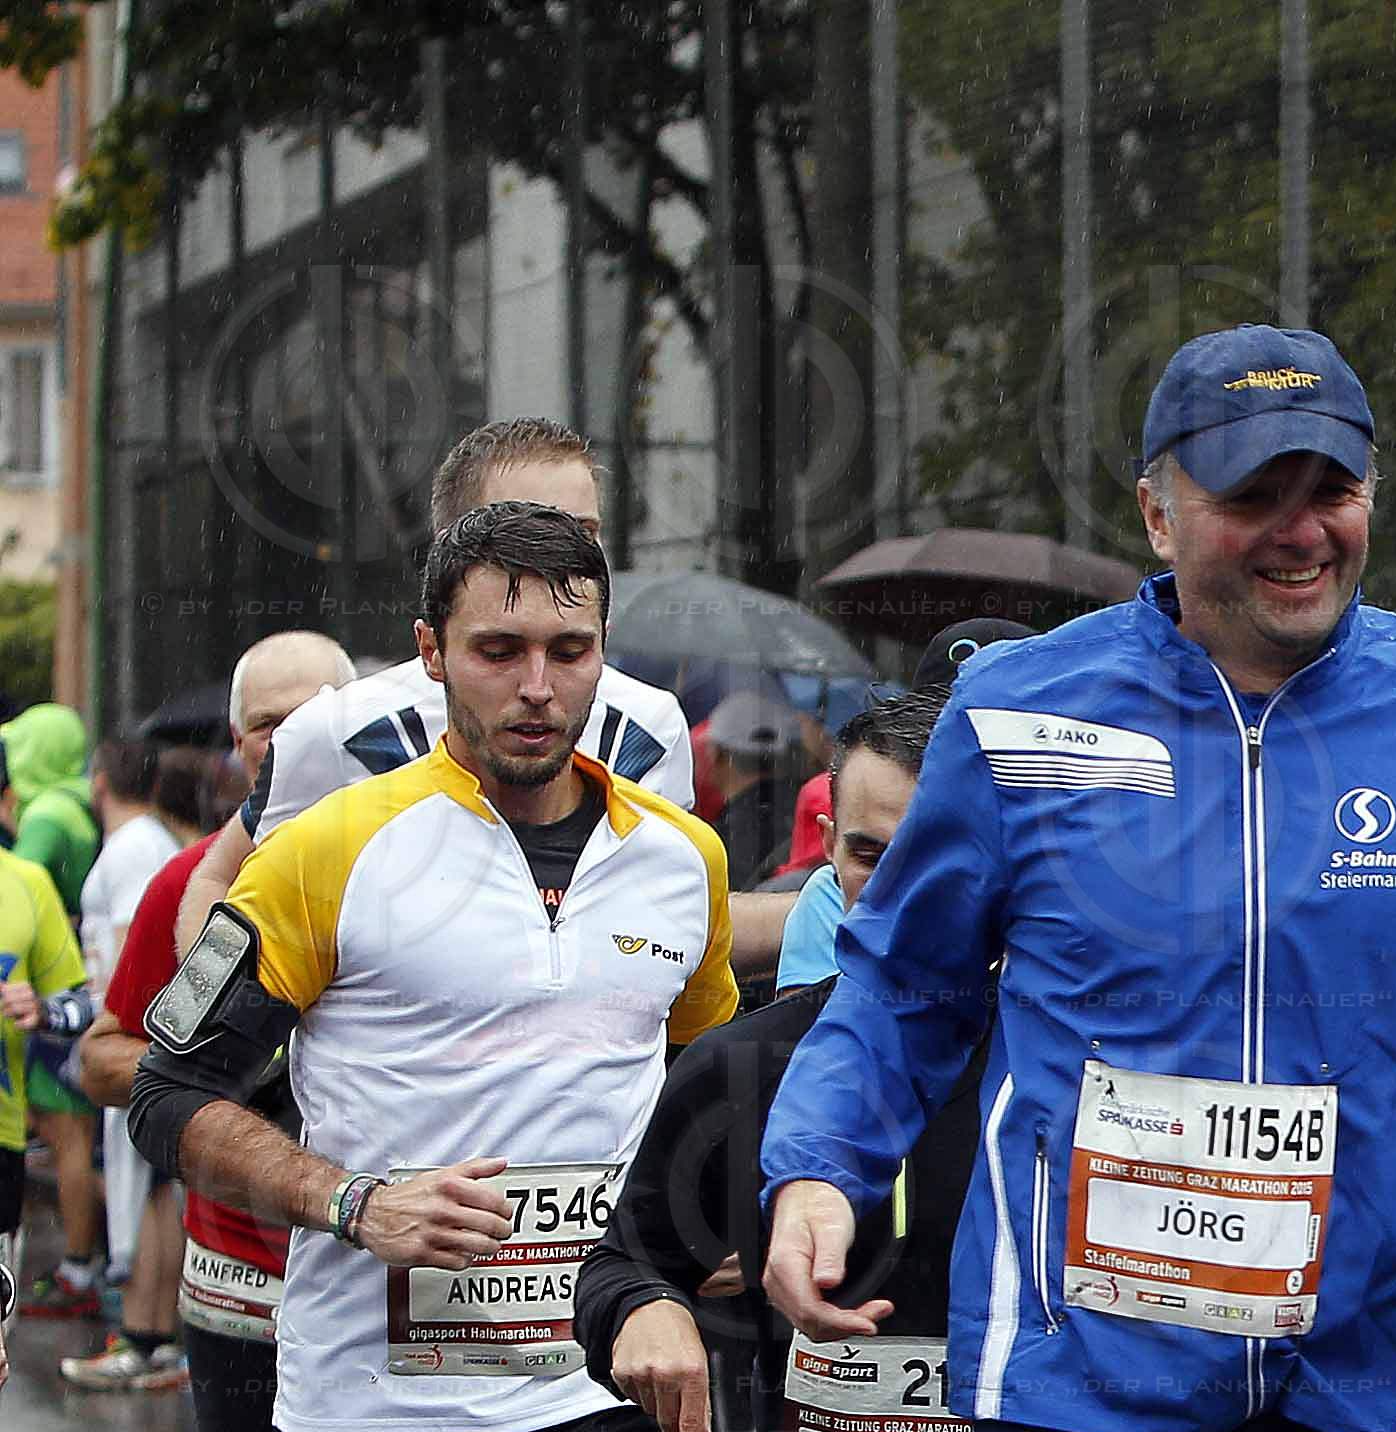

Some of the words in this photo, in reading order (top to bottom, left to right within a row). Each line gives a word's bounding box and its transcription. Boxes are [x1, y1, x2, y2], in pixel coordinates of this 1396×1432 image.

[1053, 728, 1099, 746] JAKO
[651, 943, 685, 965] Post
[1206, 1102, 1324, 1163] 11154B
[1088, 1157, 1129, 1177] KLEINE
[1132, 1161, 1184, 1184] ZEITUNG
[1186, 1169, 1218, 1190] GRAZ
[1221, 1175, 1290, 1196] MARATHON
[1289, 1180, 1313, 1196] 2015
[1157, 1200, 1247, 1243] JÖRG
[496, 1248, 525, 1261] GRAZ
[526, 1245, 580, 1260] MARATHON
[1084, 1249, 1191, 1281] Staffelmarathon
[447, 1273, 572, 1304] ANDREAS
[409, 1326, 466, 1341] gigasport
[470, 1325, 552, 1340] Halbmarathon
[802, 1357, 830, 1374] giga
[832, 1365, 875, 1380] sport
[798, 1409, 831, 1428] KLEINE
